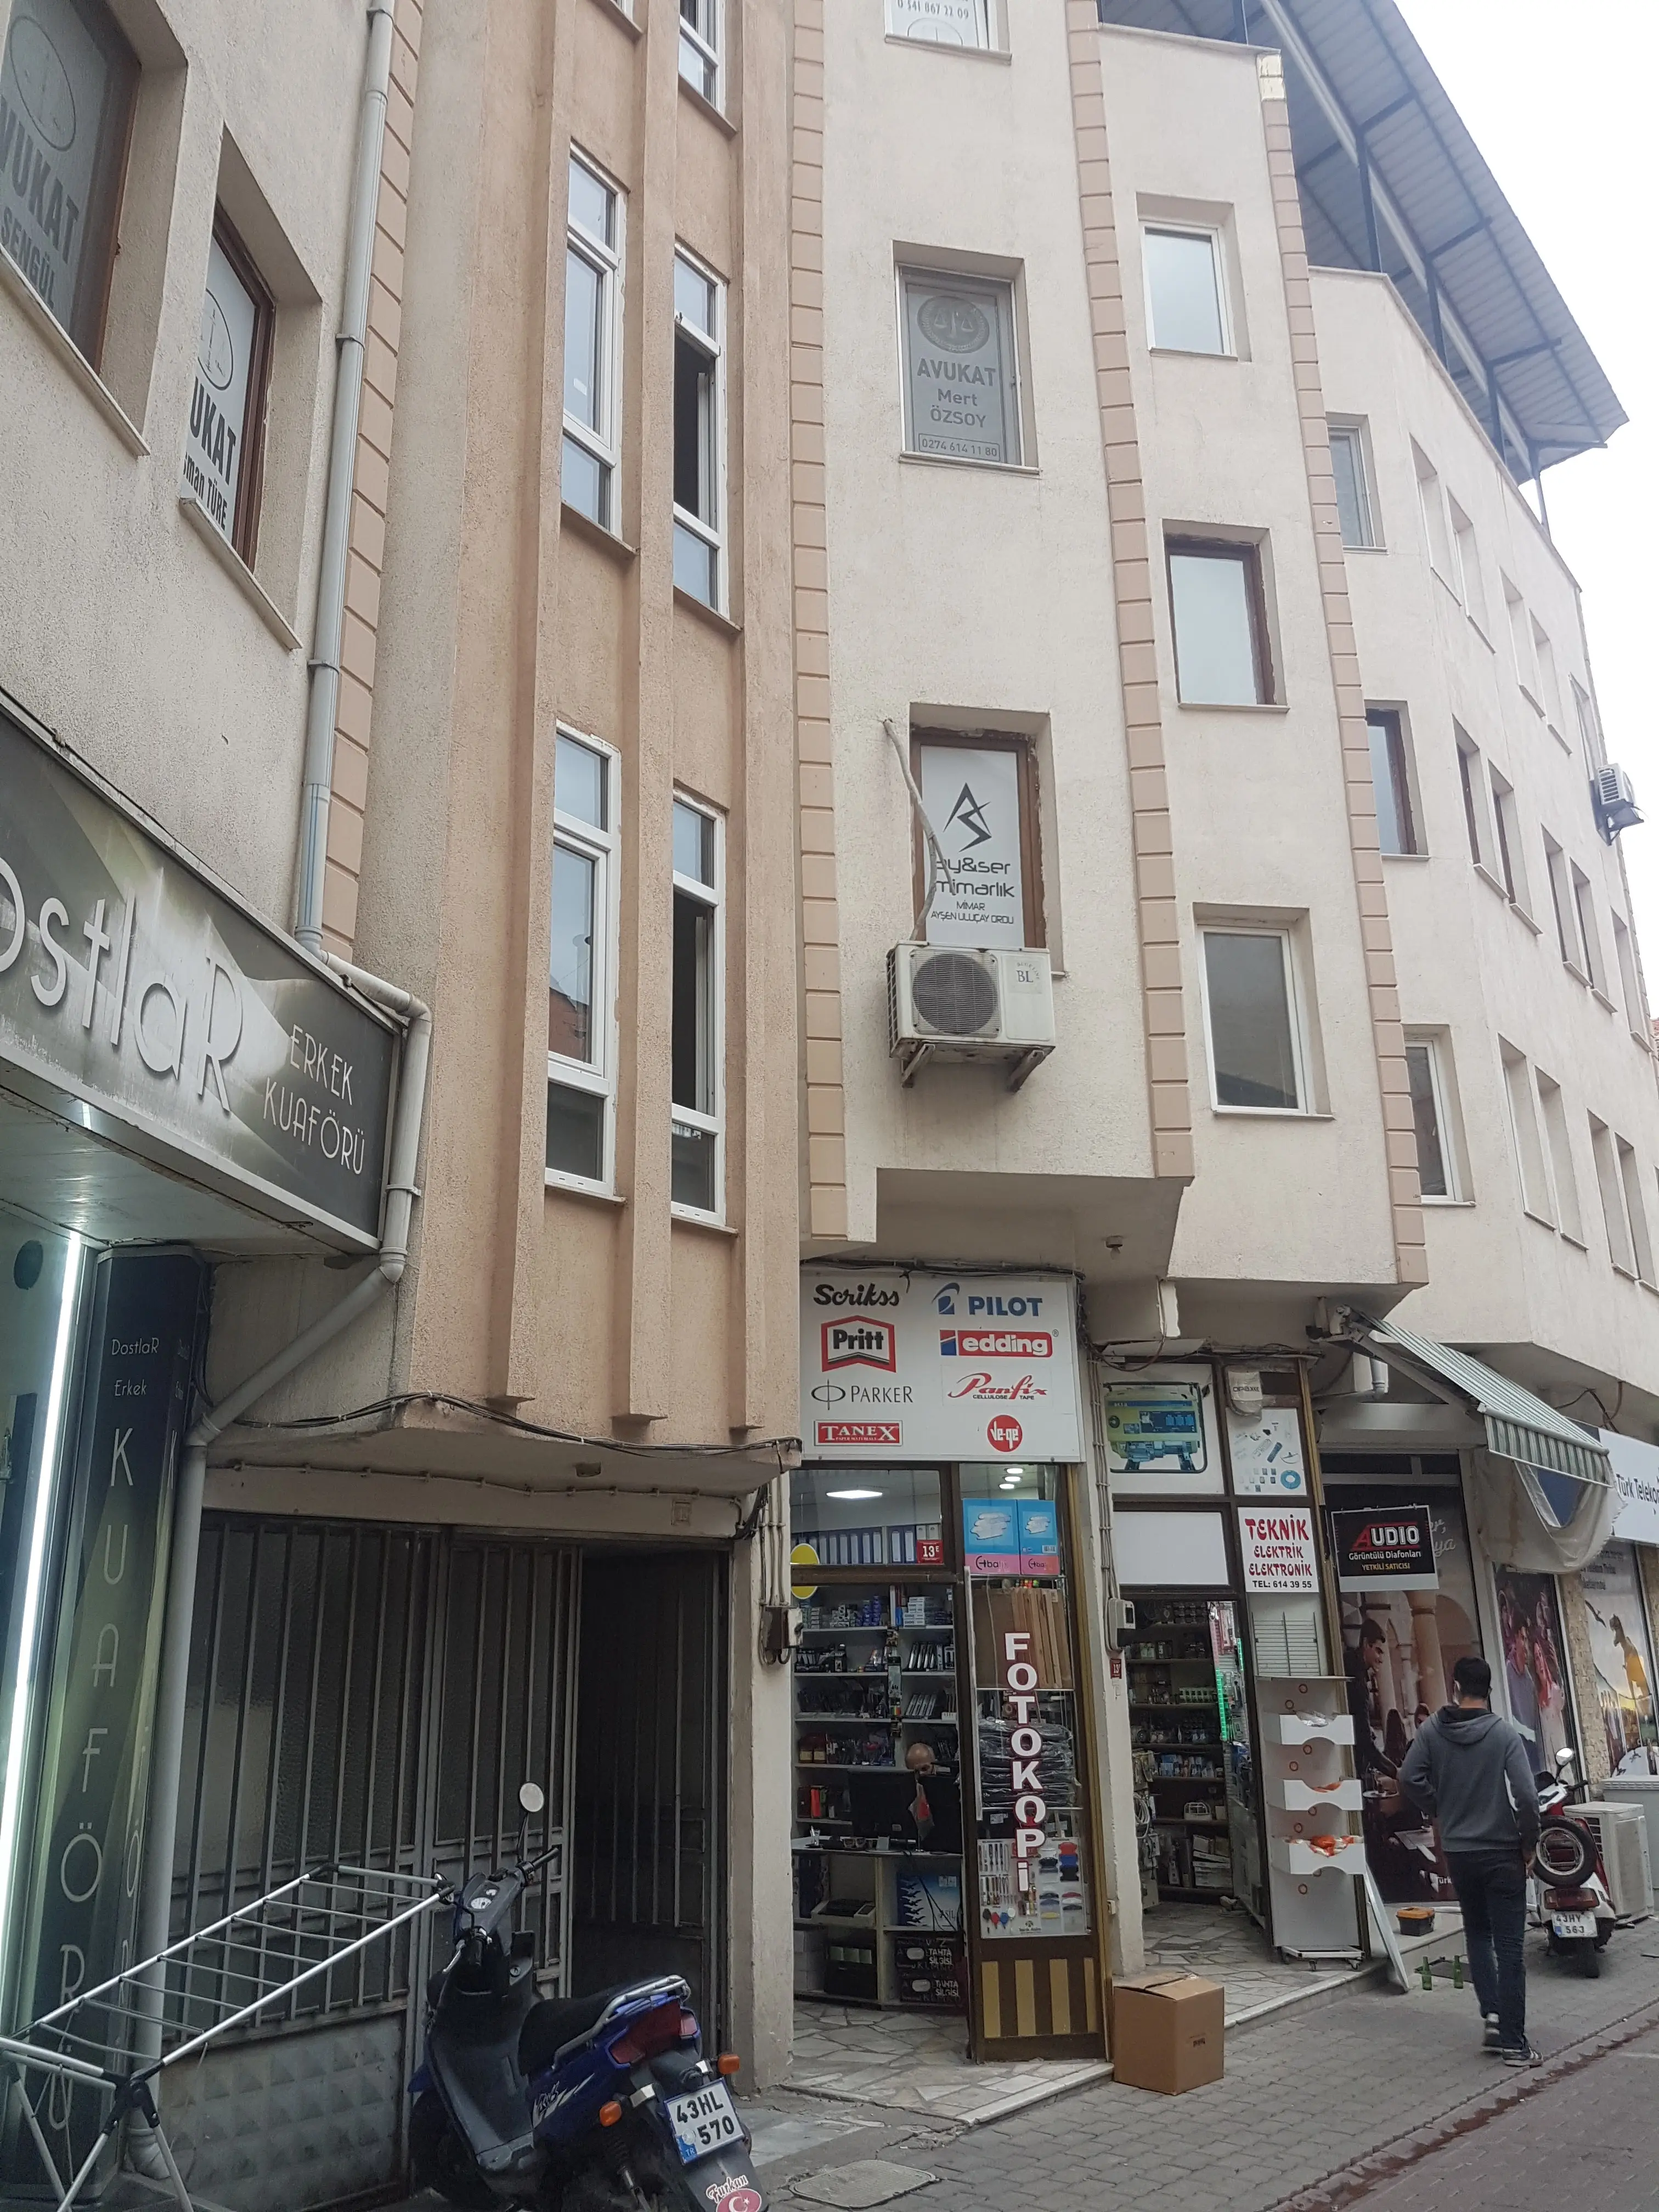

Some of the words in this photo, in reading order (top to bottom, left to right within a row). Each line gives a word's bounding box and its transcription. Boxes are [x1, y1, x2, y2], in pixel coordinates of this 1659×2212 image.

[917, 358, 996, 387] AVUKAT
[938, 388, 978, 407] Mert
[930, 405, 986, 427] ÖZSOY
[922, 439, 947, 450] 0274
[950, 442, 968, 453] 614
[972, 445, 981, 455] 11
[985, 447, 997, 456] 80
[183, 452, 205, 500] man
[956, 900, 985, 911] MİMAR
[931, 911, 956, 921] AYŞEN
[958, 913, 990, 923] ULUÇAY
[991, 915, 1014, 924] ORDU
[1016, 970, 1034, 983] BL
[289, 1024, 353, 1106] ERKEK
[262, 1077, 366, 1175] KUAFÖRÜ
[814, 1282, 900, 1307] Scrikss
[968, 1296, 1043, 1317] PILOT
[111, 1337, 159, 1355] DostlaR
[833, 1329, 883, 1350] Pritt
[962, 1334, 1048, 1357] edding
[114, 1379, 147, 1396] Erkek
[851, 1385, 913, 1403] PARKER
[947, 1372, 1048, 1400] Panfix
[821, 1425, 900, 1441] TANEX
[1616, 1474, 1634, 1498] Türk
[1245, 1514, 1310, 1541] TEKNİK
[1351, 1522, 1420, 1550] AUDIO
[1254, 1543, 1304, 1559] ELEKTRİK
[1348, 1551, 1384, 1560] Görüntülü
[1386, 1550, 1421, 1559] Diafonları
[1249, 1560, 1313, 1576] ELEKTRONİK
[676, 2091, 724, 2123] 43HL
[697, 2115, 735, 2145] 570
[685, 2148, 695, 2156] TR
